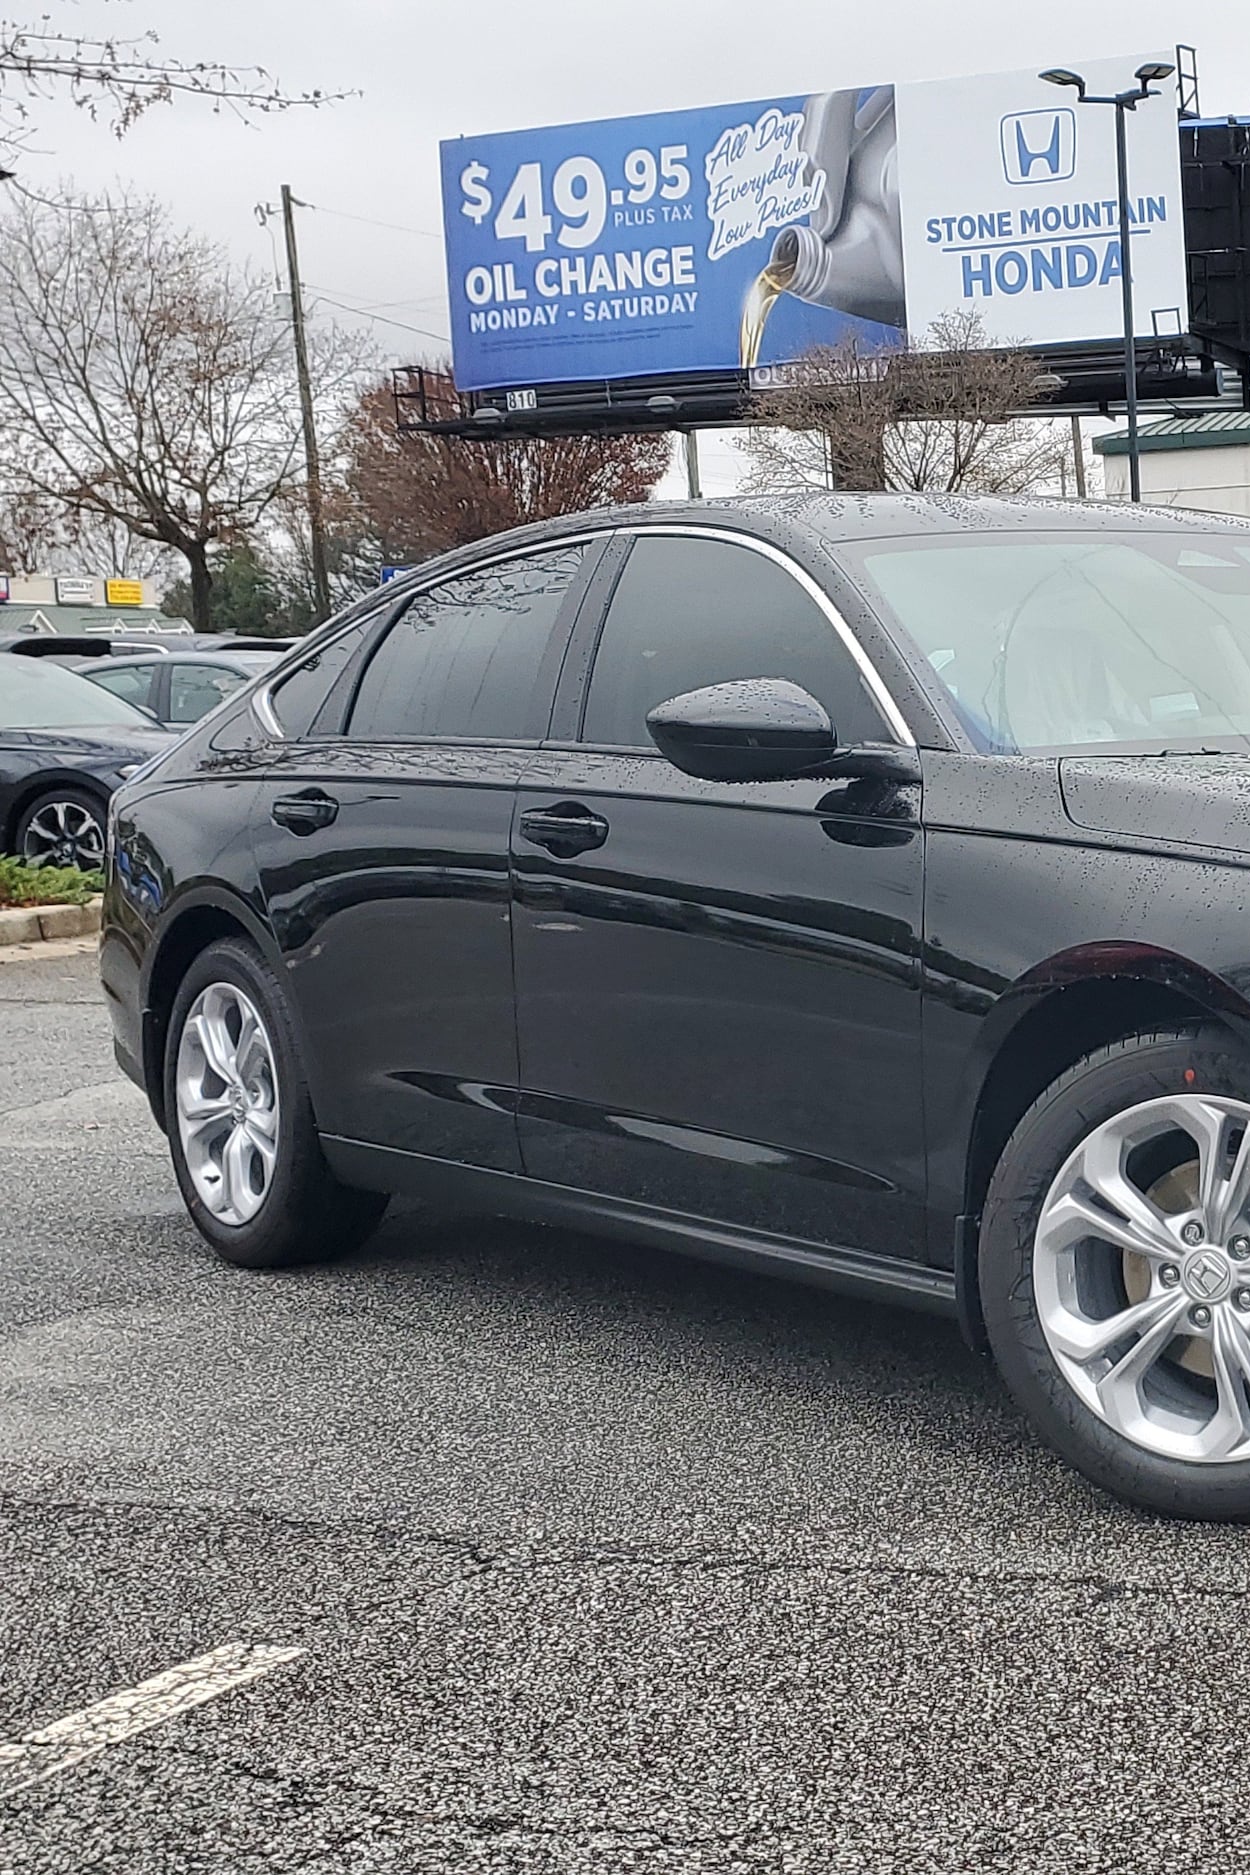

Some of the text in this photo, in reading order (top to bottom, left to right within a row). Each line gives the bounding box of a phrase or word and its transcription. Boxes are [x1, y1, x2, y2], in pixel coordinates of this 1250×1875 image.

[710, 115, 800, 175] All Day
[712, 153, 803, 214] Everyday
[614, 204, 693, 227] PLUS TAX
[713, 175, 822, 254] Low Prices!
[926, 211, 1013, 243] STONE
[465, 247, 696, 305] OIL CHANGE
[961, 240, 1127, 298] HONDA
[470, 304, 559, 333] MONDAY
[583, 292, 698, 321] SATURDAY
[508, 390, 536, 410] 810
